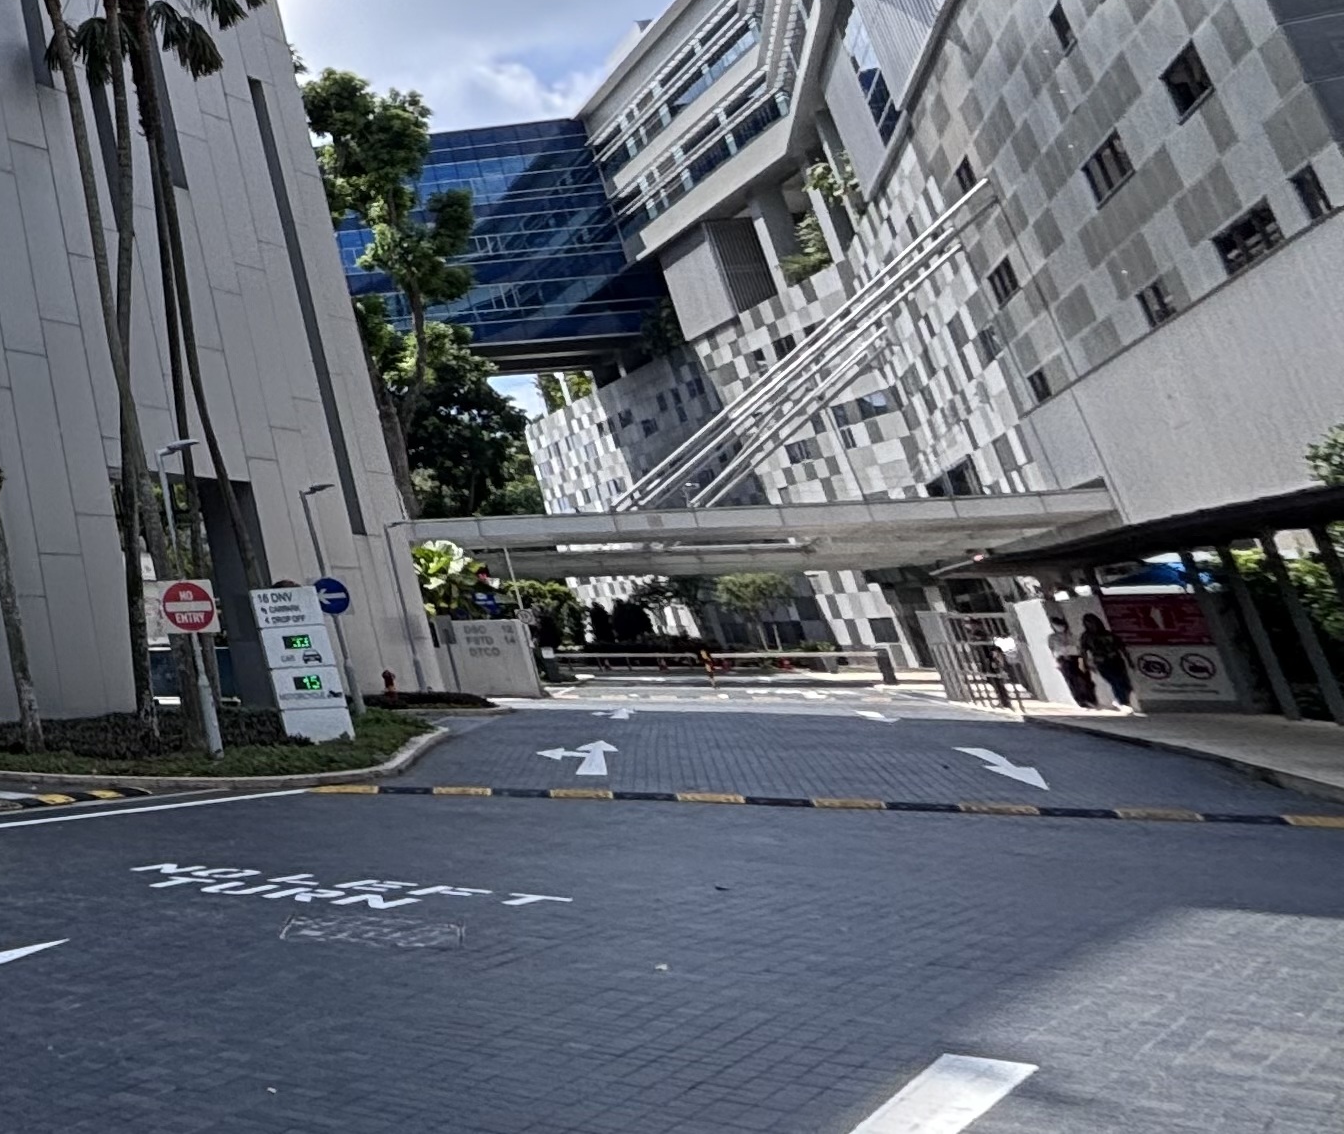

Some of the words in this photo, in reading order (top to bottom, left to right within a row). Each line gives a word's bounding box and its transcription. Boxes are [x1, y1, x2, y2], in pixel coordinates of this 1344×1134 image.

[178, 590, 193, 601] NO
[257, 593, 269, 603] 16
[271, 592, 292, 603] DNV
[174, 612, 204, 624] ENTRY
